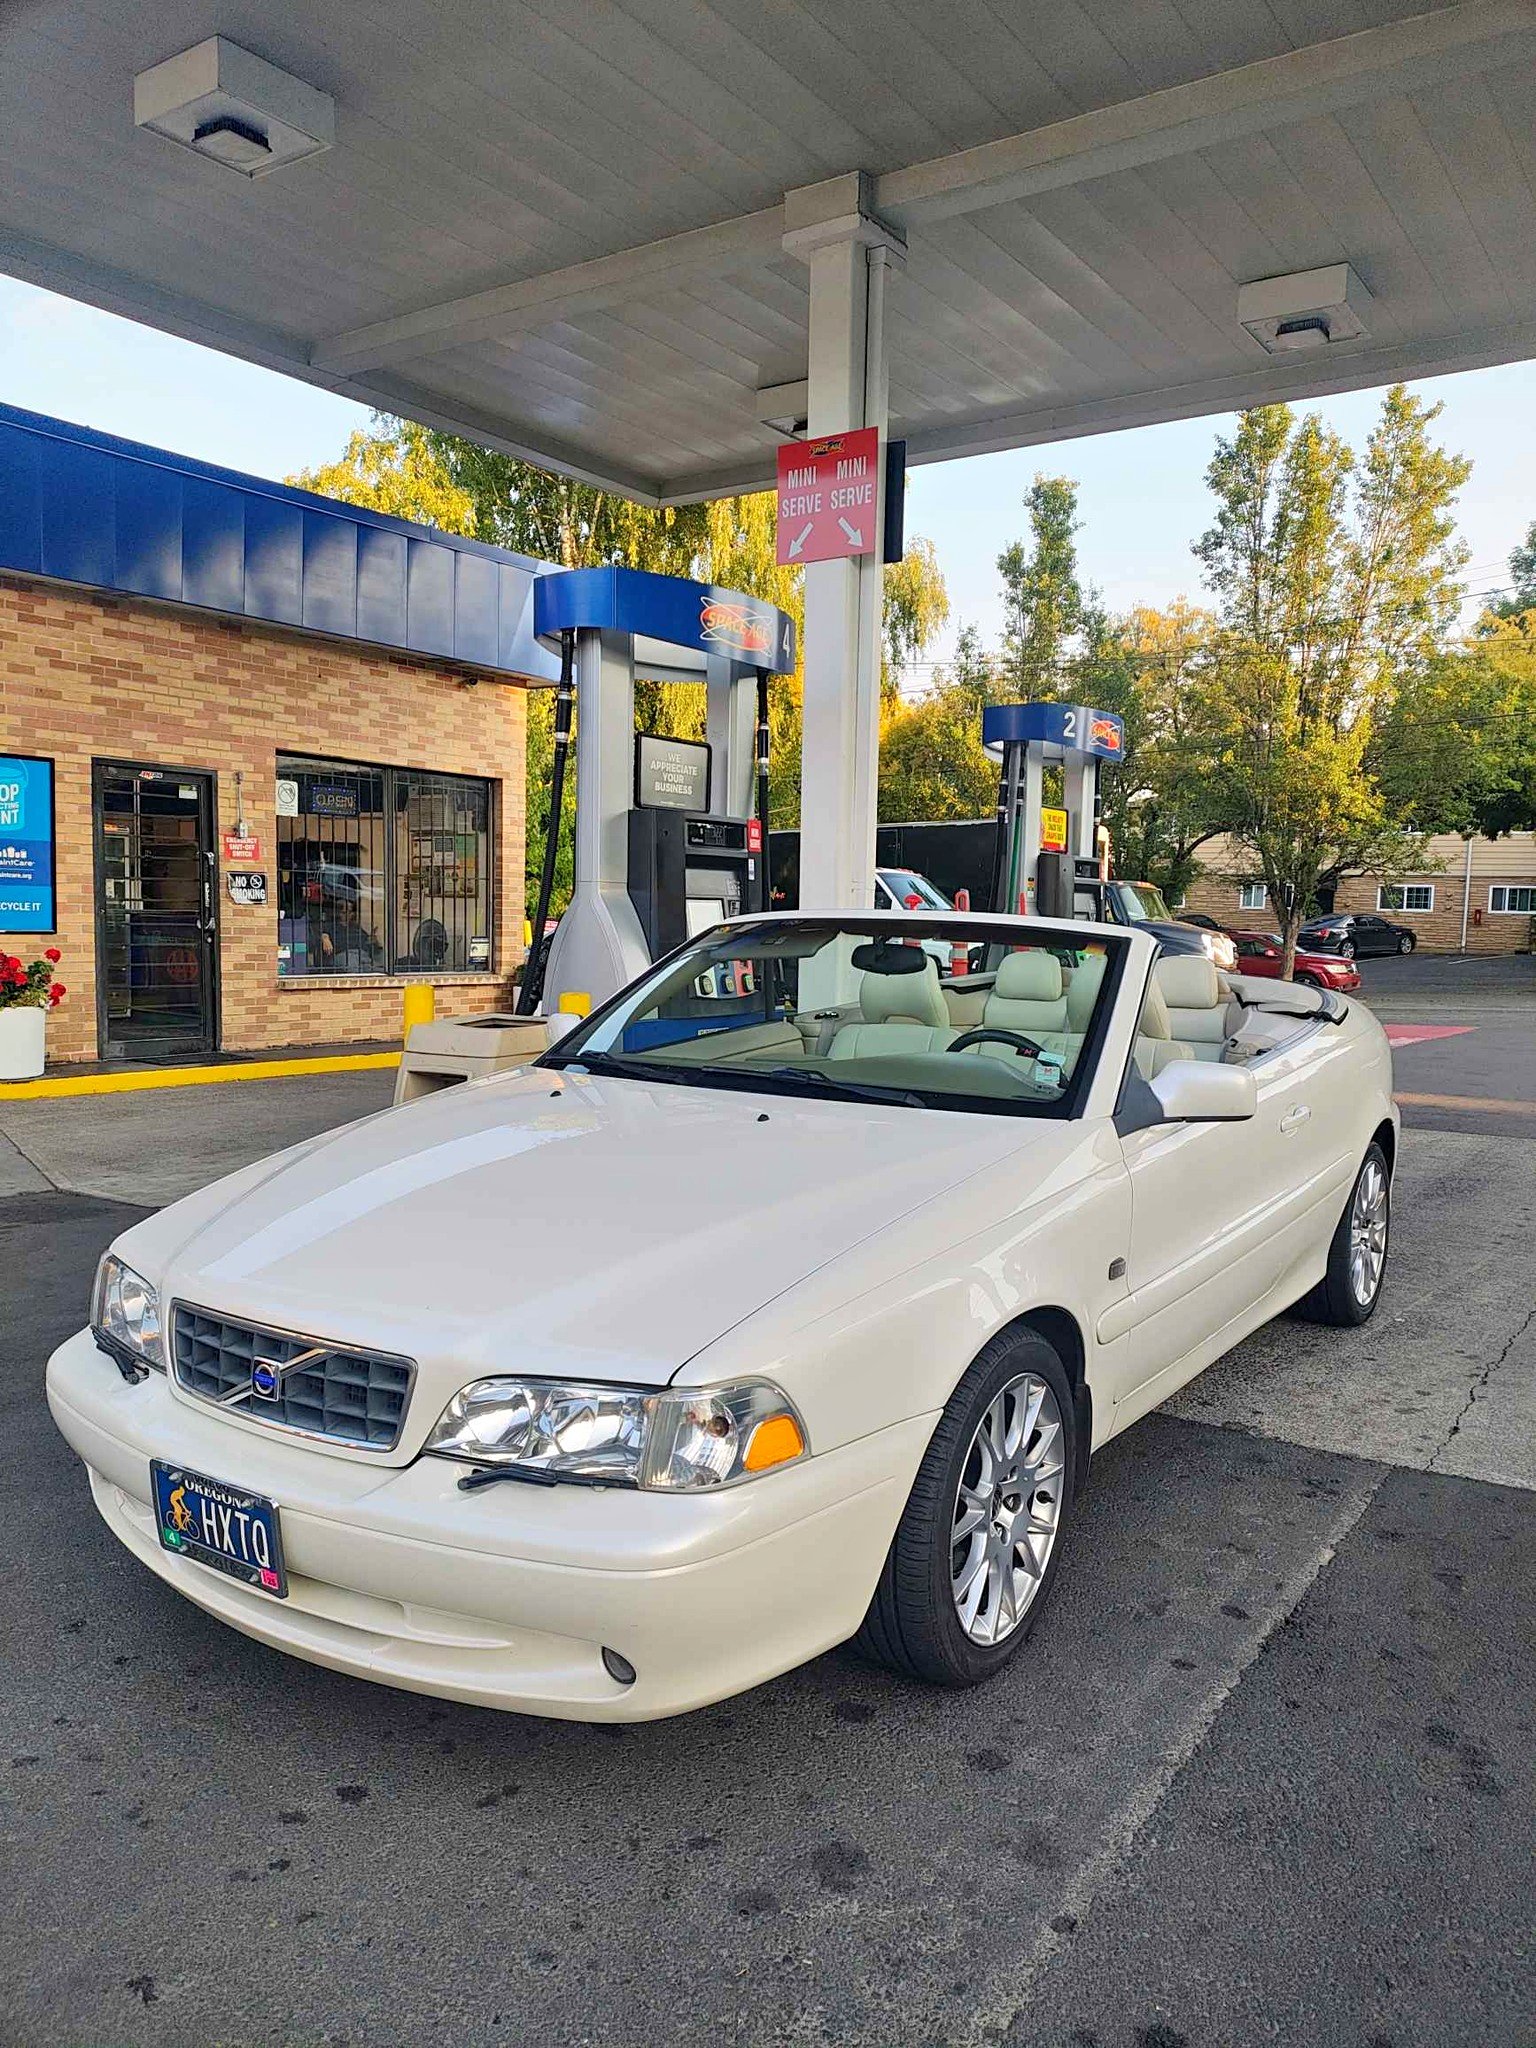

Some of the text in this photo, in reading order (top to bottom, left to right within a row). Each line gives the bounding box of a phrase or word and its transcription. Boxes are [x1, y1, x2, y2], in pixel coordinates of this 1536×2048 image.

[837, 455, 867, 480] MINI
[787, 466, 817, 490] MINI
[830, 483, 873, 510] SERVE
[782, 493, 822, 518] SERVE
[782, 623, 791, 659] 4
[1063, 711, 1076, 738] 2
[667, 752, 682, 763] WE
[650, 760, 698, 776] APPRECIATE
[662, 772, 685, 784] YOUR
[654, 781, 693, 795] BUSINESS
[231, 850, 253, 858] SWITCH
[235, 876, 247, 887] NO
[231, 888, 266, 900] SMOKING
[0, 902, 41, 912] CYCLE IT
[184, 1479, 242, 1508] OREGON
[168, 1532, 176, 1544] 4
[201, 1498, 270, 1568] HXTQ
